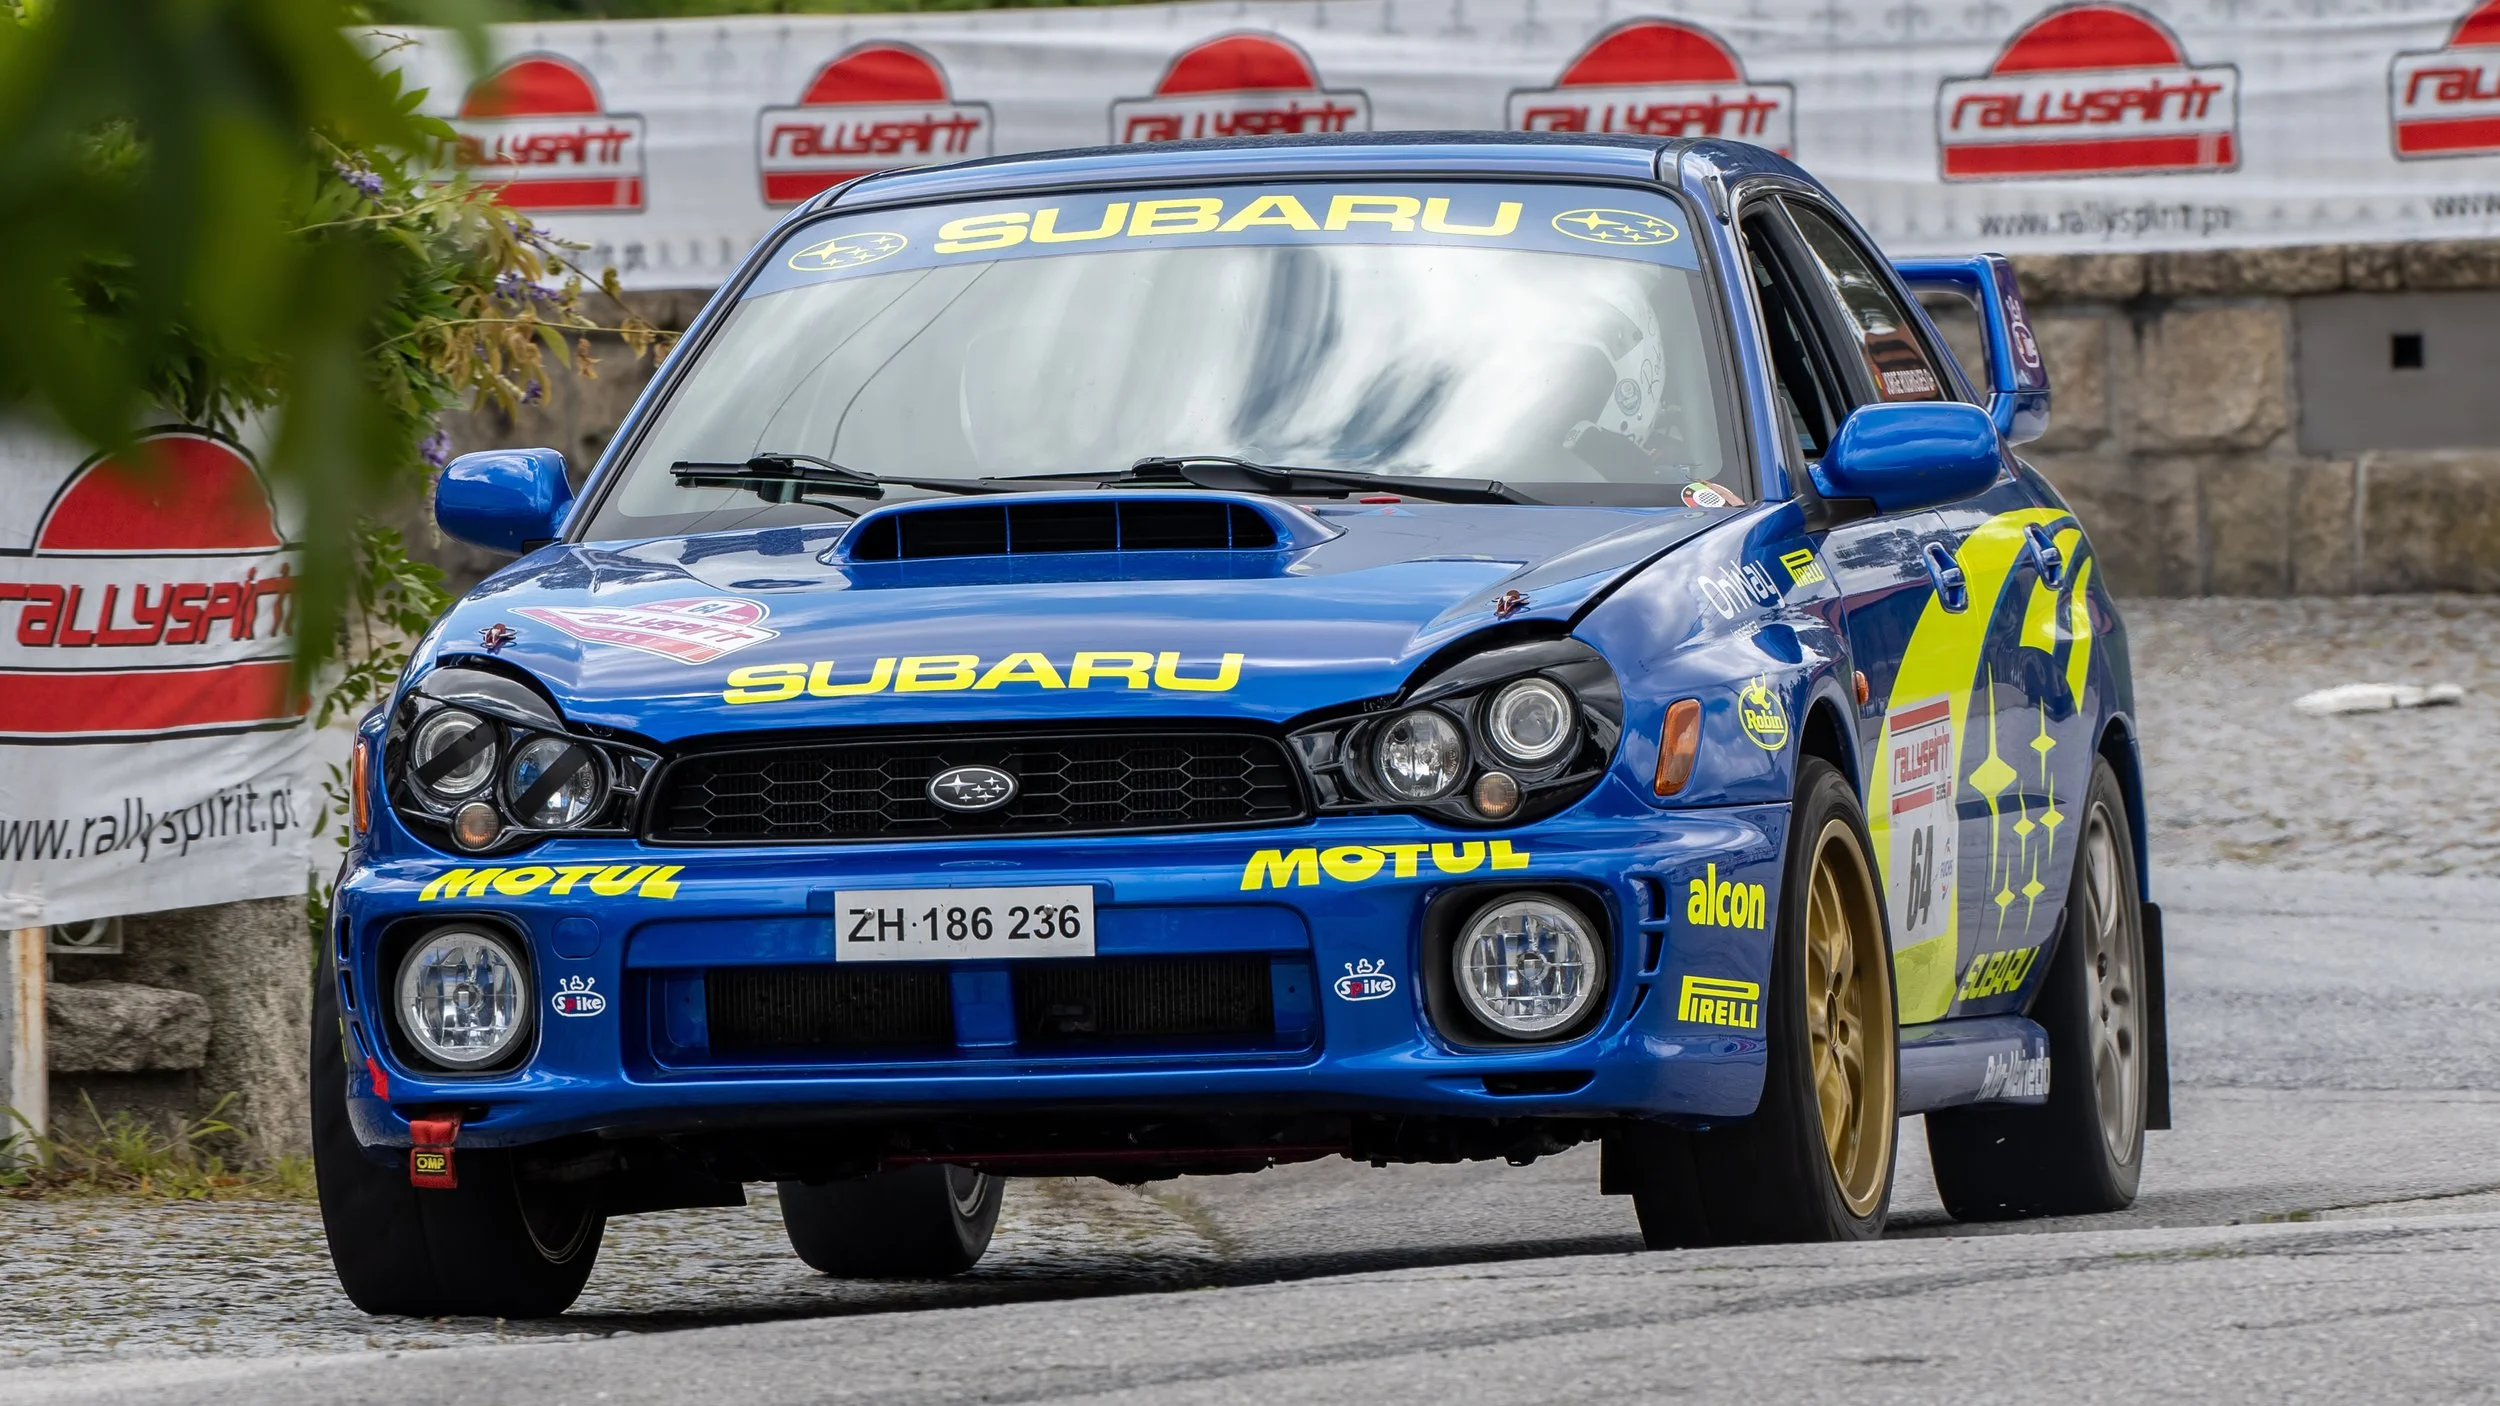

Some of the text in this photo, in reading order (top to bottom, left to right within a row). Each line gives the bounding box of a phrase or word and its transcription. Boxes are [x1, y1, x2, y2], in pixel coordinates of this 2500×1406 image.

[1949, 78, 2224, 131] rallyspirit
[767, 112, 981, 160] rallyspirit
[933, 195, 1524, 254] SUBARU
[1697, 560, 1785, 620] OnWay
[1779, 548, 1826, 588] PIRELLI
[723, 652, 1245, 704] SUBARU
[1744, 709, 1785, 733] Robin
[418, 865, 685, 901] MOTUL
[1240, 840, 1530, 890] MOTUL
[1906, 824, 1934, 932] 64
[1687, 863, 1766, 930] alcon
[1008, 904, 1081, 941] 236
[1339, 978, 1393, 998] Spike
[1958, 946, 2040, 1001] SUBARU
[556, 995, 603, 1014] Spike
[1678, 975, 1760, 1029] PIRELLI
[416, 1156, 446, 1170] OMP
